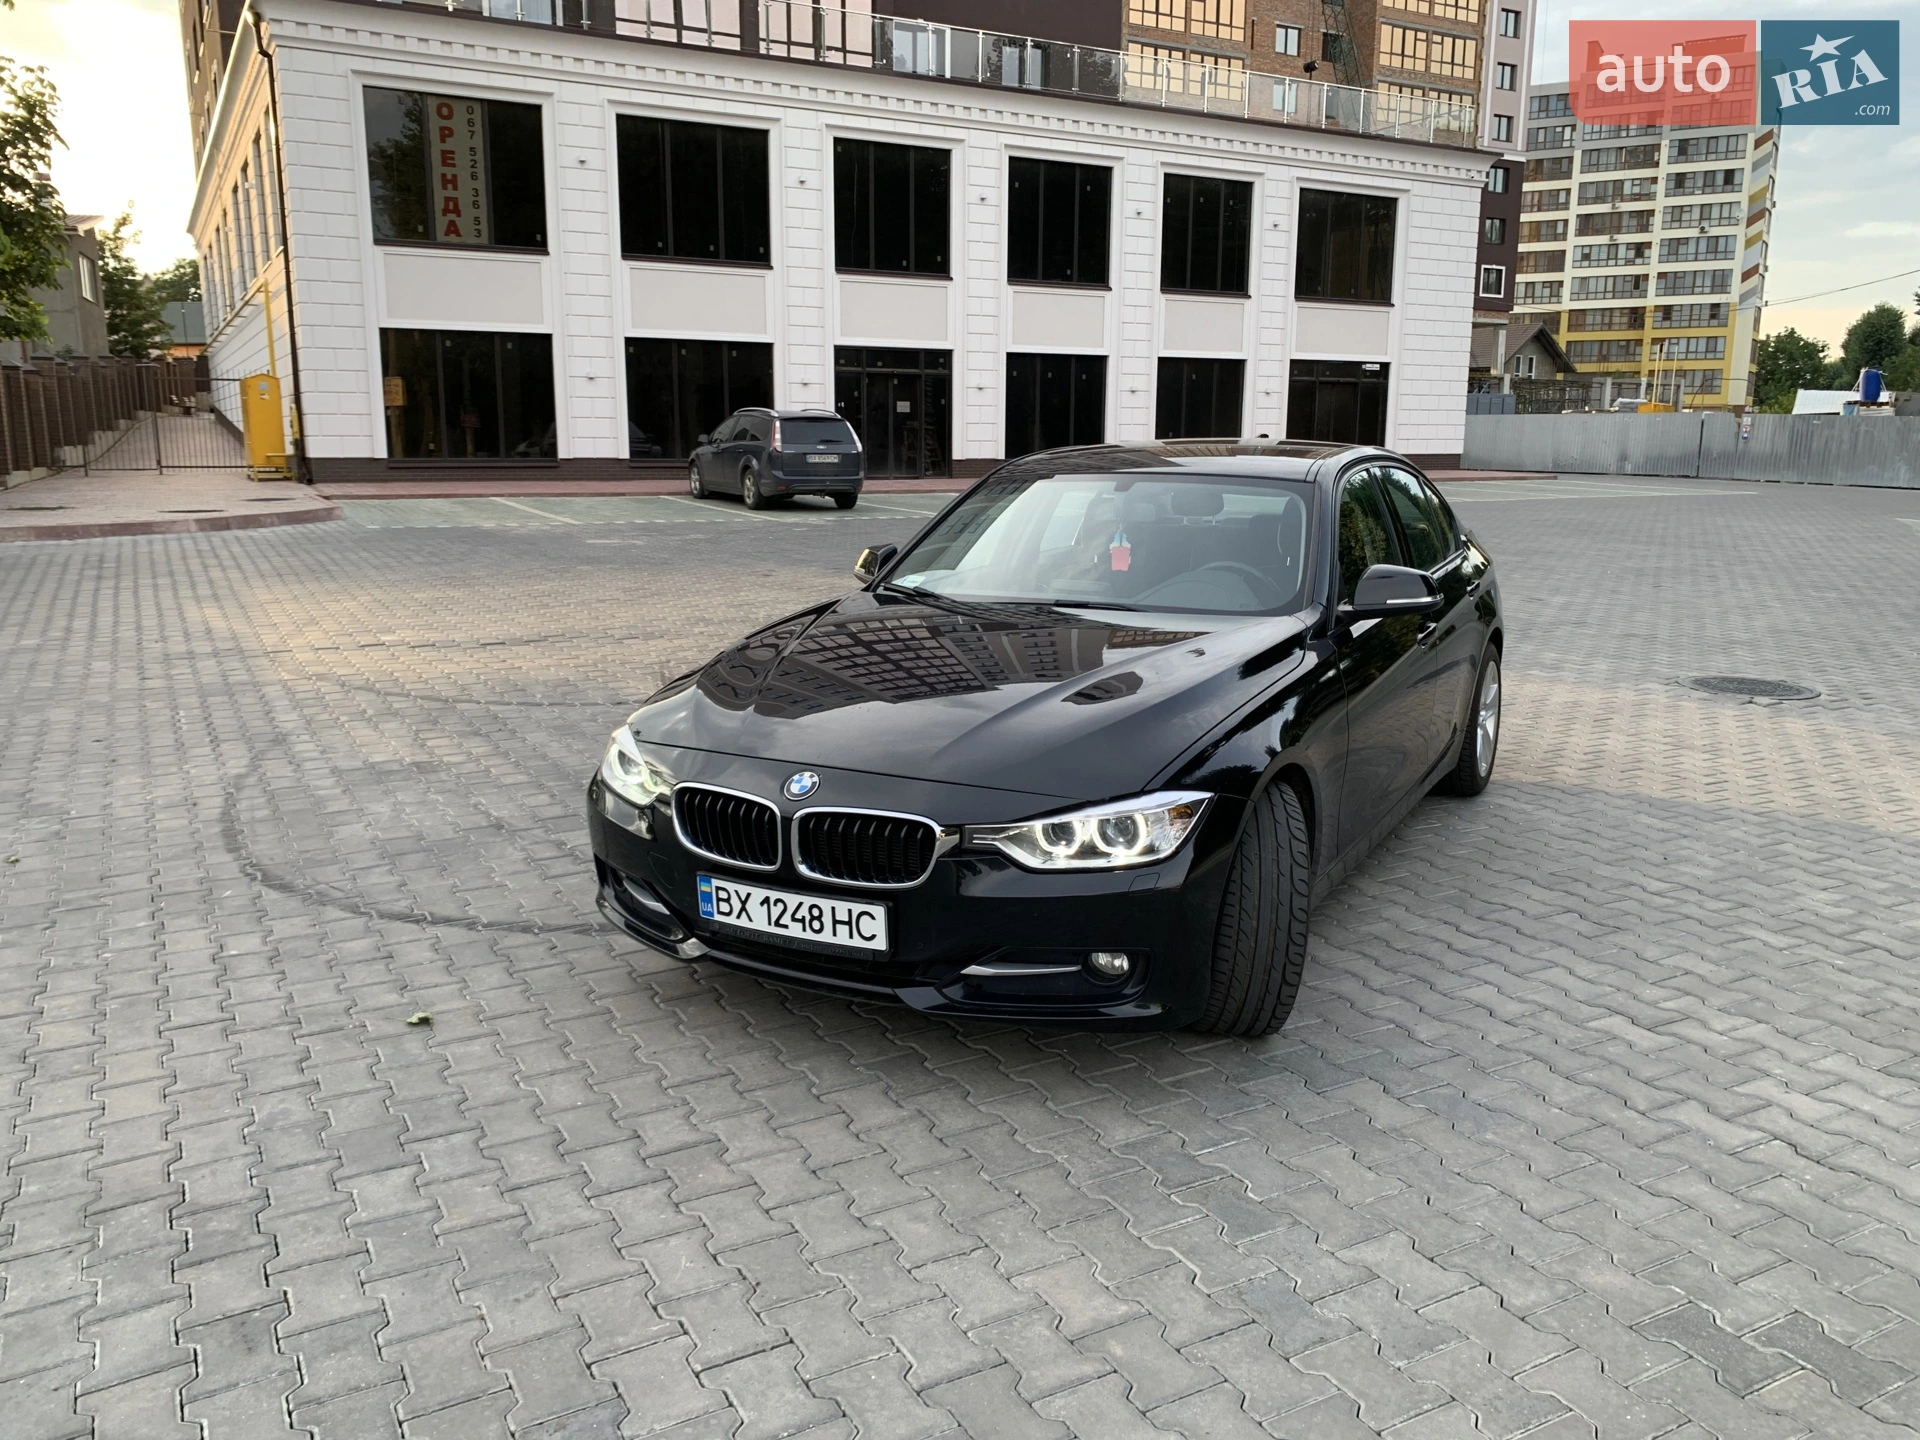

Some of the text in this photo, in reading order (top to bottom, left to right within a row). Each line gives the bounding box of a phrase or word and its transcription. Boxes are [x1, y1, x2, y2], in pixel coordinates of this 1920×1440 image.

[436, 102, 462, 237] ОРЕНДА
[702, 902, 713, 913] UA
[715, 886, 877, 942] BX 1248 HC
